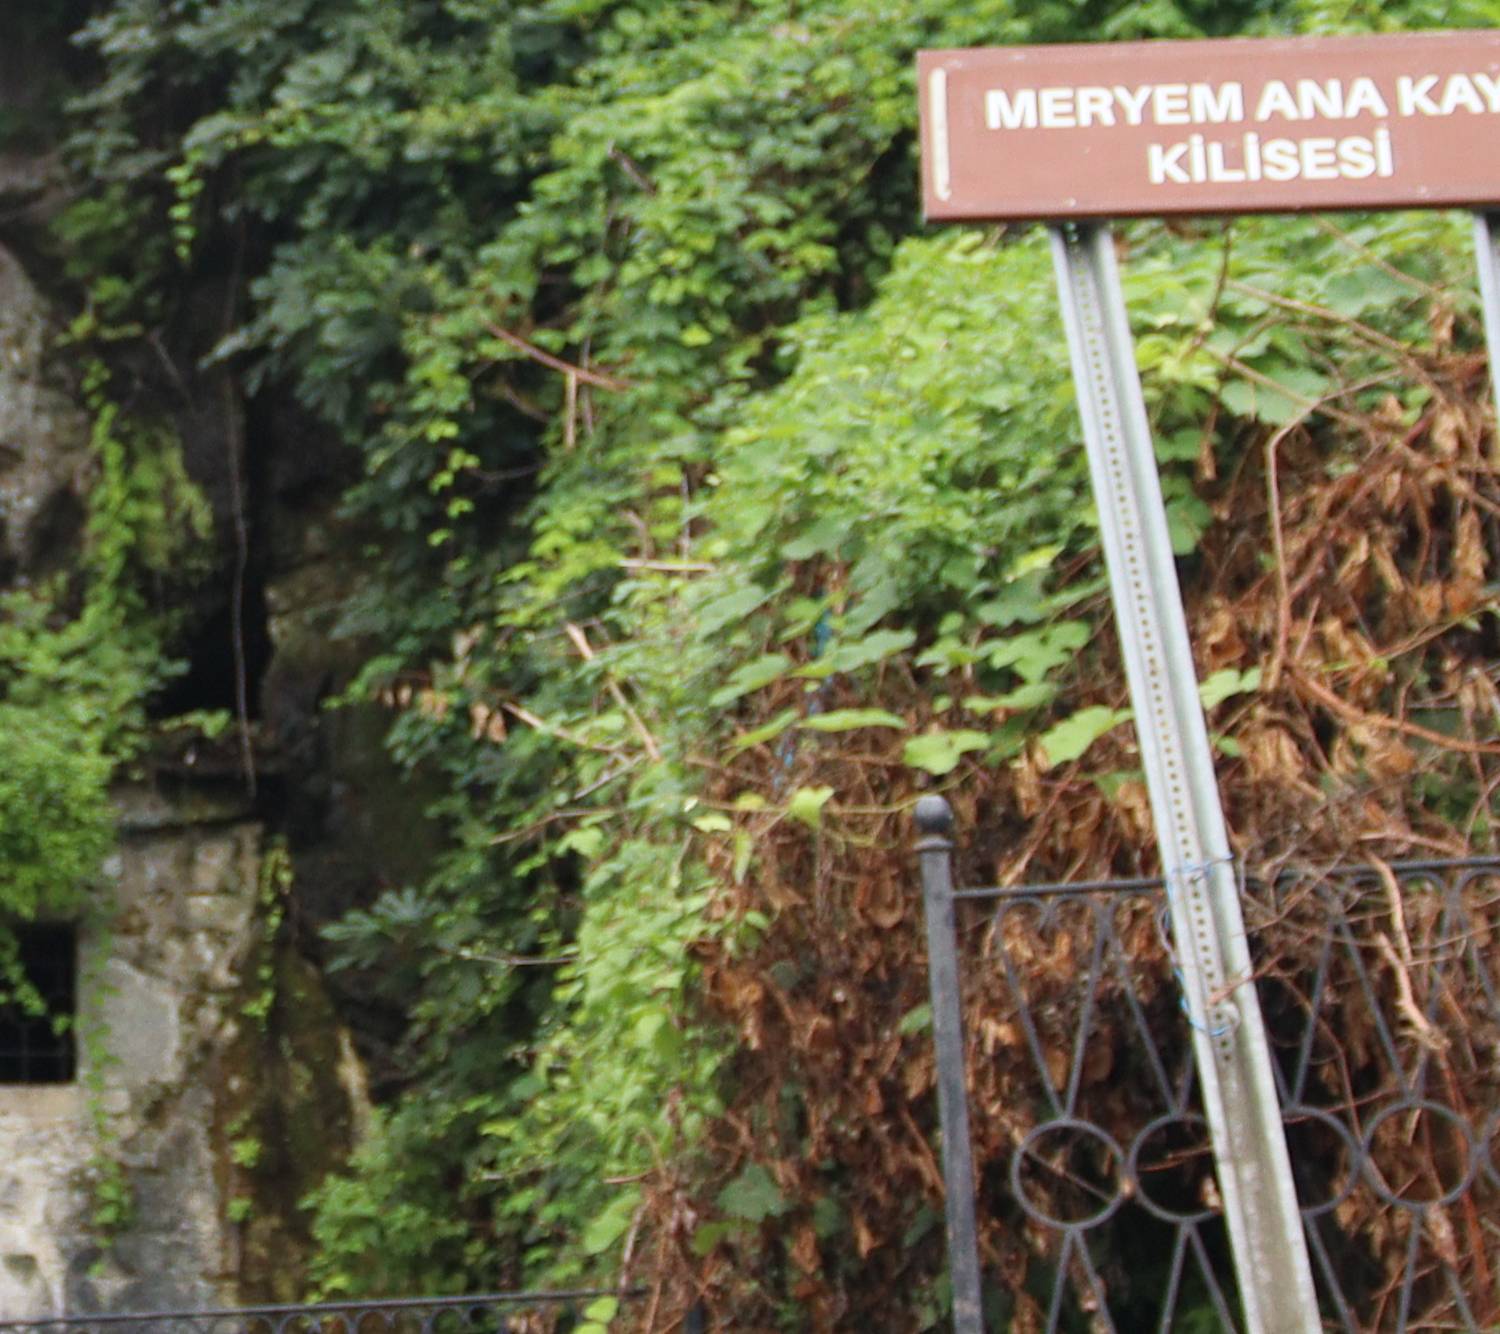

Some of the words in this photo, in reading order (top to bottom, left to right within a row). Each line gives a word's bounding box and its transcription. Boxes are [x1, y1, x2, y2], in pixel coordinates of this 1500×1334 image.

[985, 82, 1243, 129] MERYEM
[1256, 77, 1388, 121] ANA
[1148, 125, 1394, 184] KİLİSESİ
